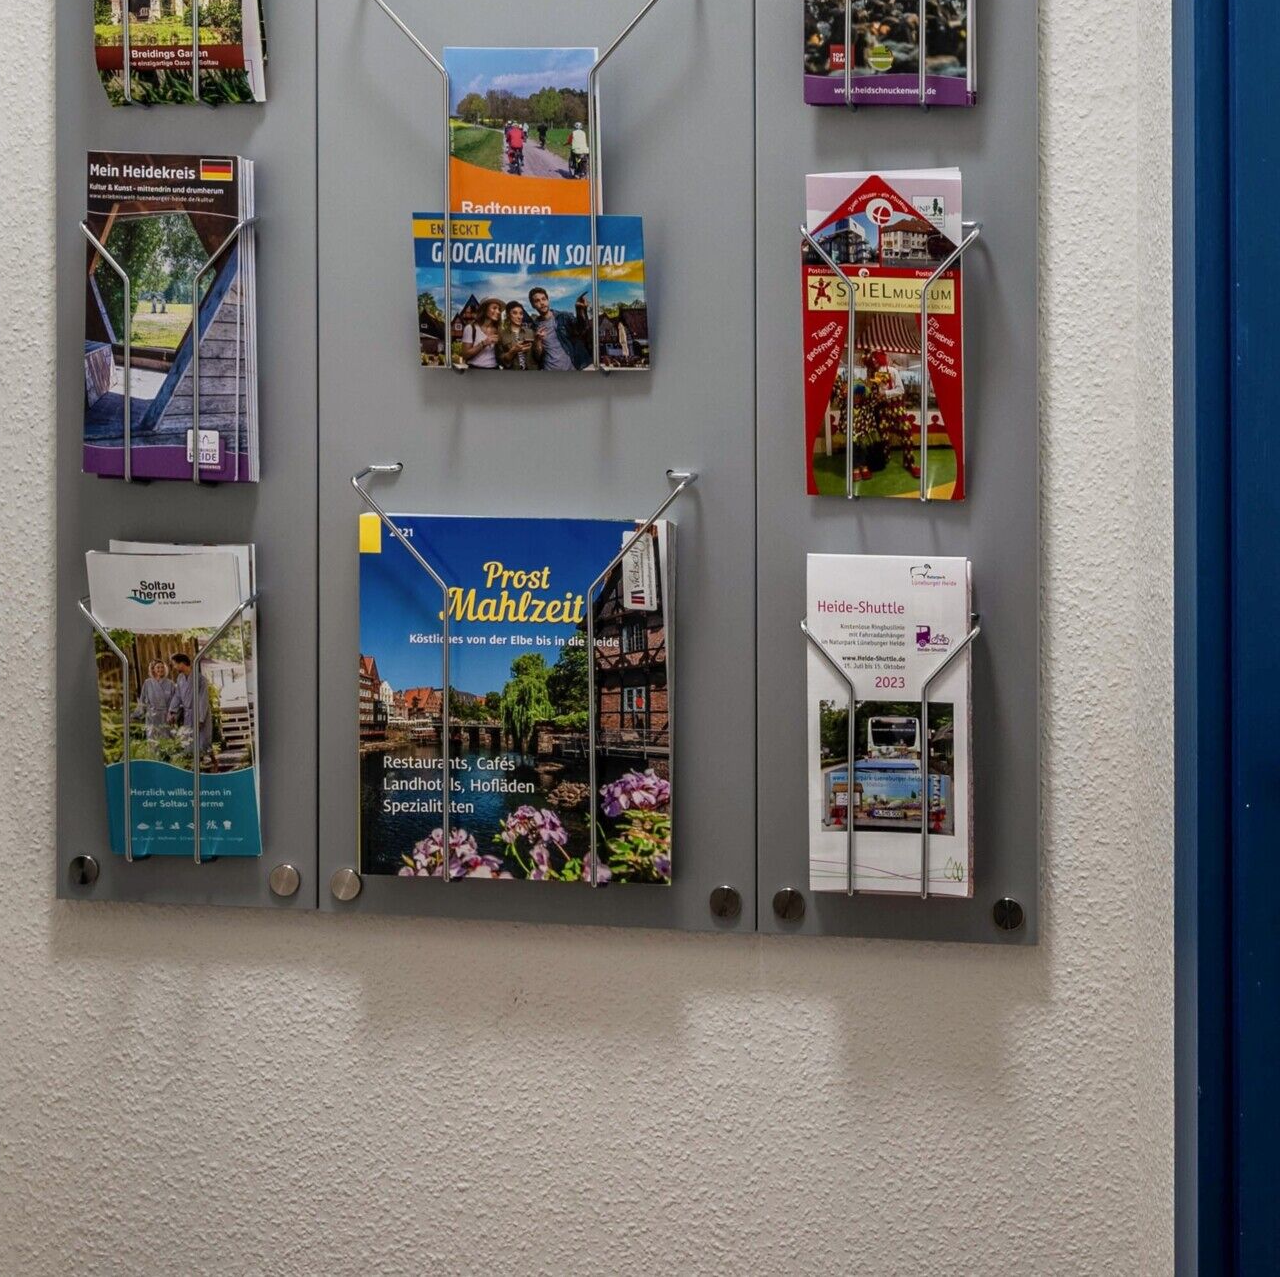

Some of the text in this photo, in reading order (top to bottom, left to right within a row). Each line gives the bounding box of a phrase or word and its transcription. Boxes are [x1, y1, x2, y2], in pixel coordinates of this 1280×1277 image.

[131, 49, 208, 59] Breidings Garen
[89, 163, 196, 179] Mein Heidekreis
[89, 183, 107, 191] Kultur
[114, 184, 132, 192] Kunst
[137, 185, 171, 193] mittendrin
[186, 186, 224, 195] drumherum
[461, 201, 552, 215] Radtouren
[541, 243, 560, 265] IN
[565, 244, 626, 266] SOLTAU
[928, 317, 939, 329] Ein
[832, 325, 843, 338] von
[927, 327, 955, 347] Erlebnis
[809, 373, 817, 383] 10
[815, 364, 827, 375] bis
[829, 344, 840, 360] Uhr
[938, 363, 957, 377] Klein
[189, 452, 217, 462] HIDE
[482, 561, 551, 590] Prost
[140, 580, 175, 590] Soltau
[131, 589, 176, 599] Therme
[438, 586, 585, 624] Mahlzeit
[817, 600, 905, 614] Heide-Shuttle
[466, 636, 486, 644] von
[489, 634, 507, 645] der
[510, 635, 533, 645] Elbe
[536, 635, 551, 645] bis
[554, 635, 565, 646] in
[568, 636, 585, 646] die
[857, 639, 888, 647] Lüneburger
[875, 676, 905, 689] 2023
[383, 756, 515, 771] Restaurants, Cafés
[383, 777, 535, 793] Landhotls, Hofläden
[130, 788, 232, 796] Herzlich willkomen in
[142, 799, 157, 807] der
[160, 799, 188, 807] Soltau
[383, 799, 474, 815] Spezialitten
